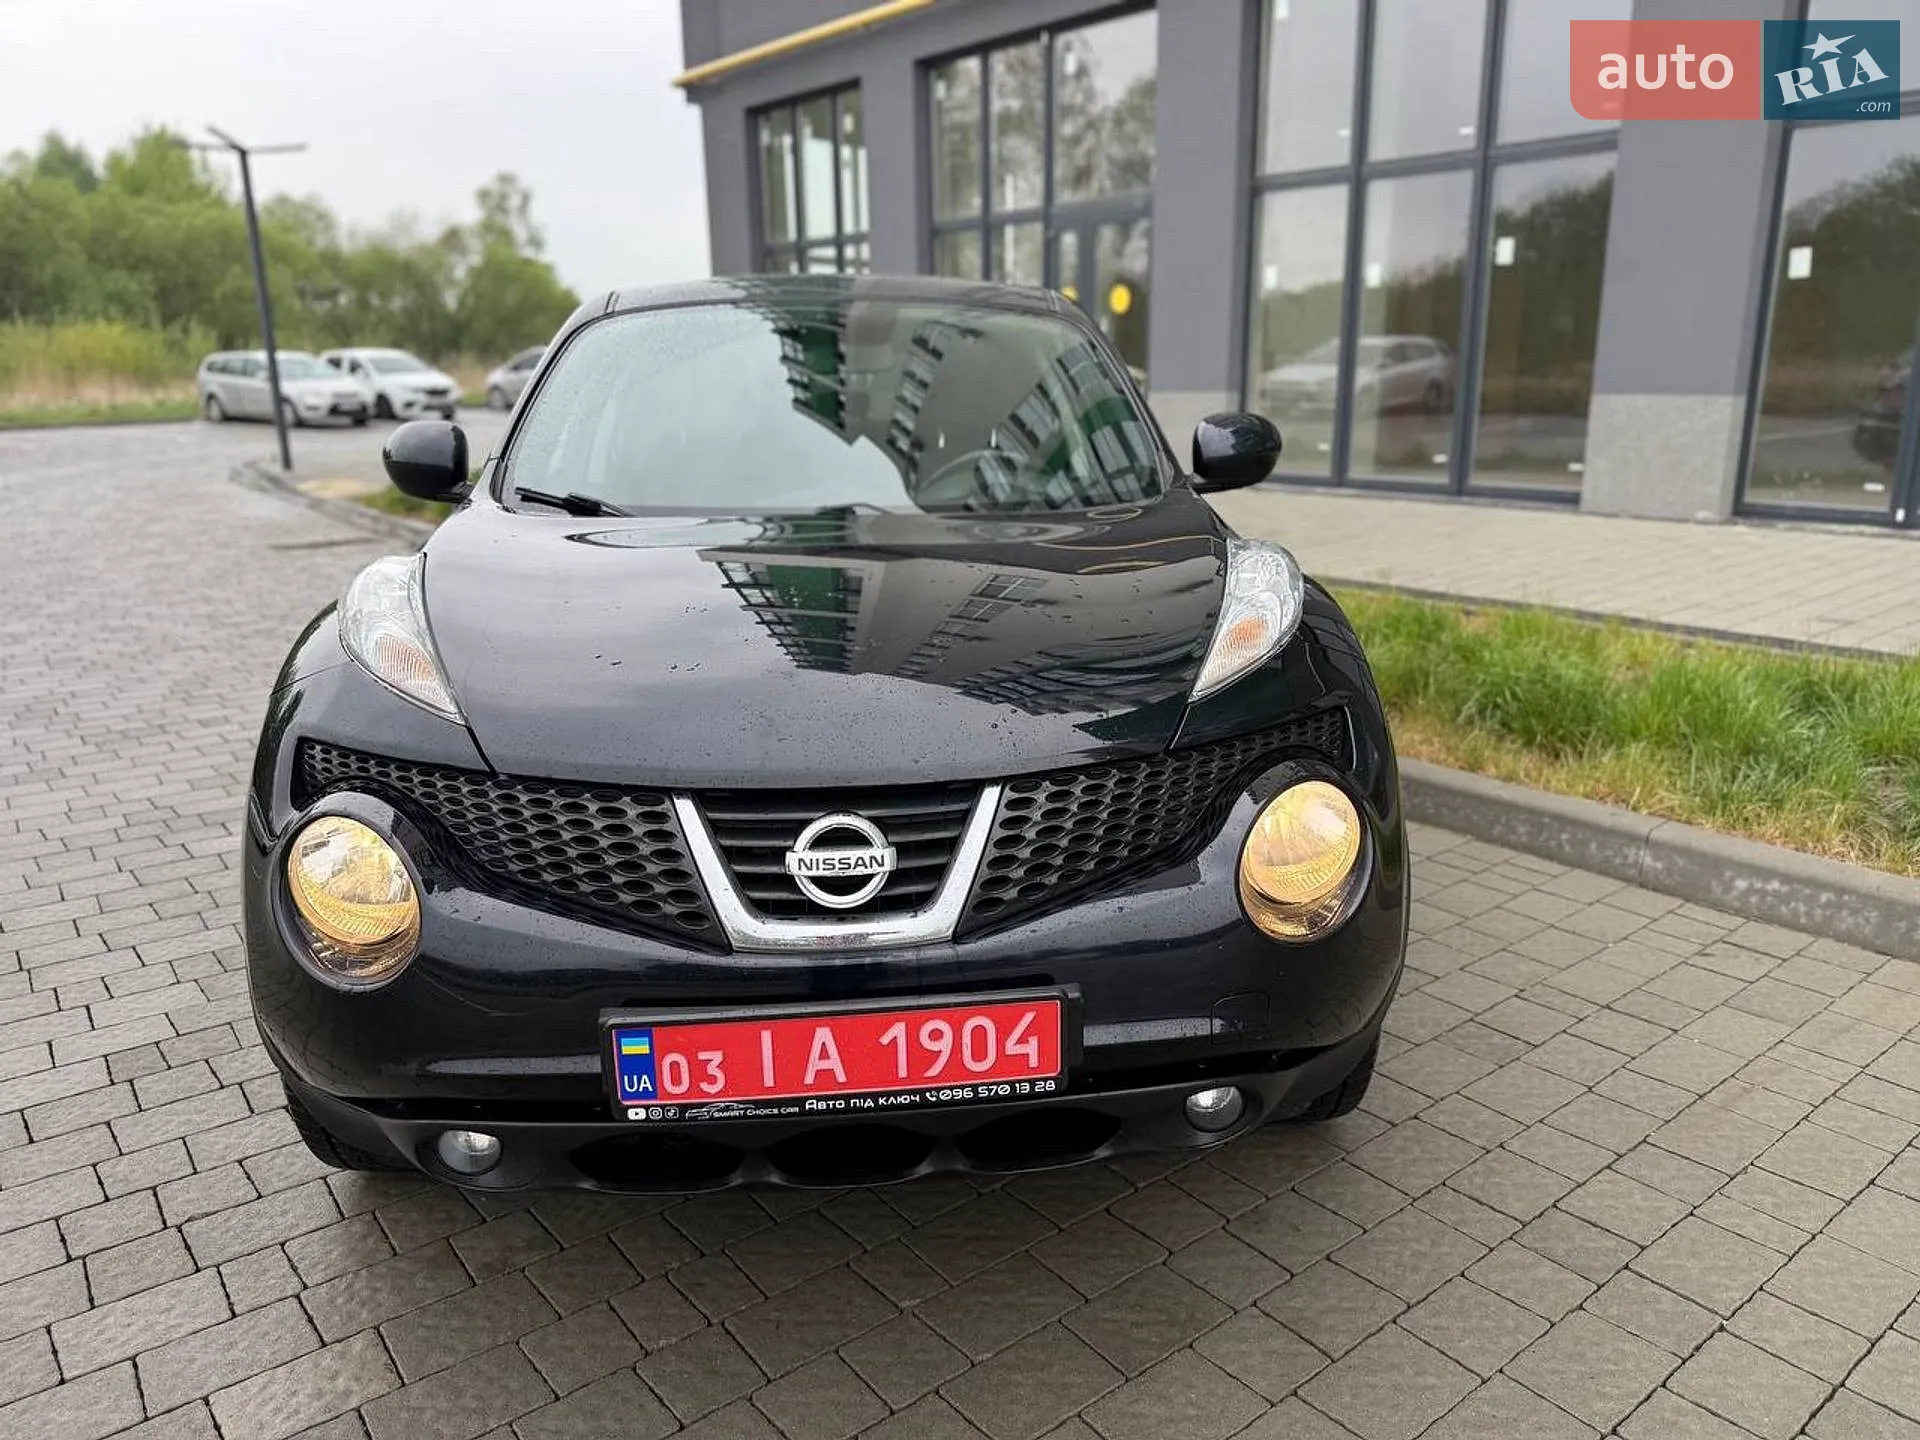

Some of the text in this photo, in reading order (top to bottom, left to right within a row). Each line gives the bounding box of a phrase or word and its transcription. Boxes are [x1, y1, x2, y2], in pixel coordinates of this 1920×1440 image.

[798, 854, 885, 872] NISSAN
[661, 1050, 726, 1095] 03
[878, 1010, 1040, 1080] 1904
[623, 1075, 653, 1092] UA
[938, 1087, 974, 1101] 096
[978, 1084, 1011, 1098] 570
[1015, 1082, 1030, 1095] 13
[1034, 1080, 1056, 1092] 28
